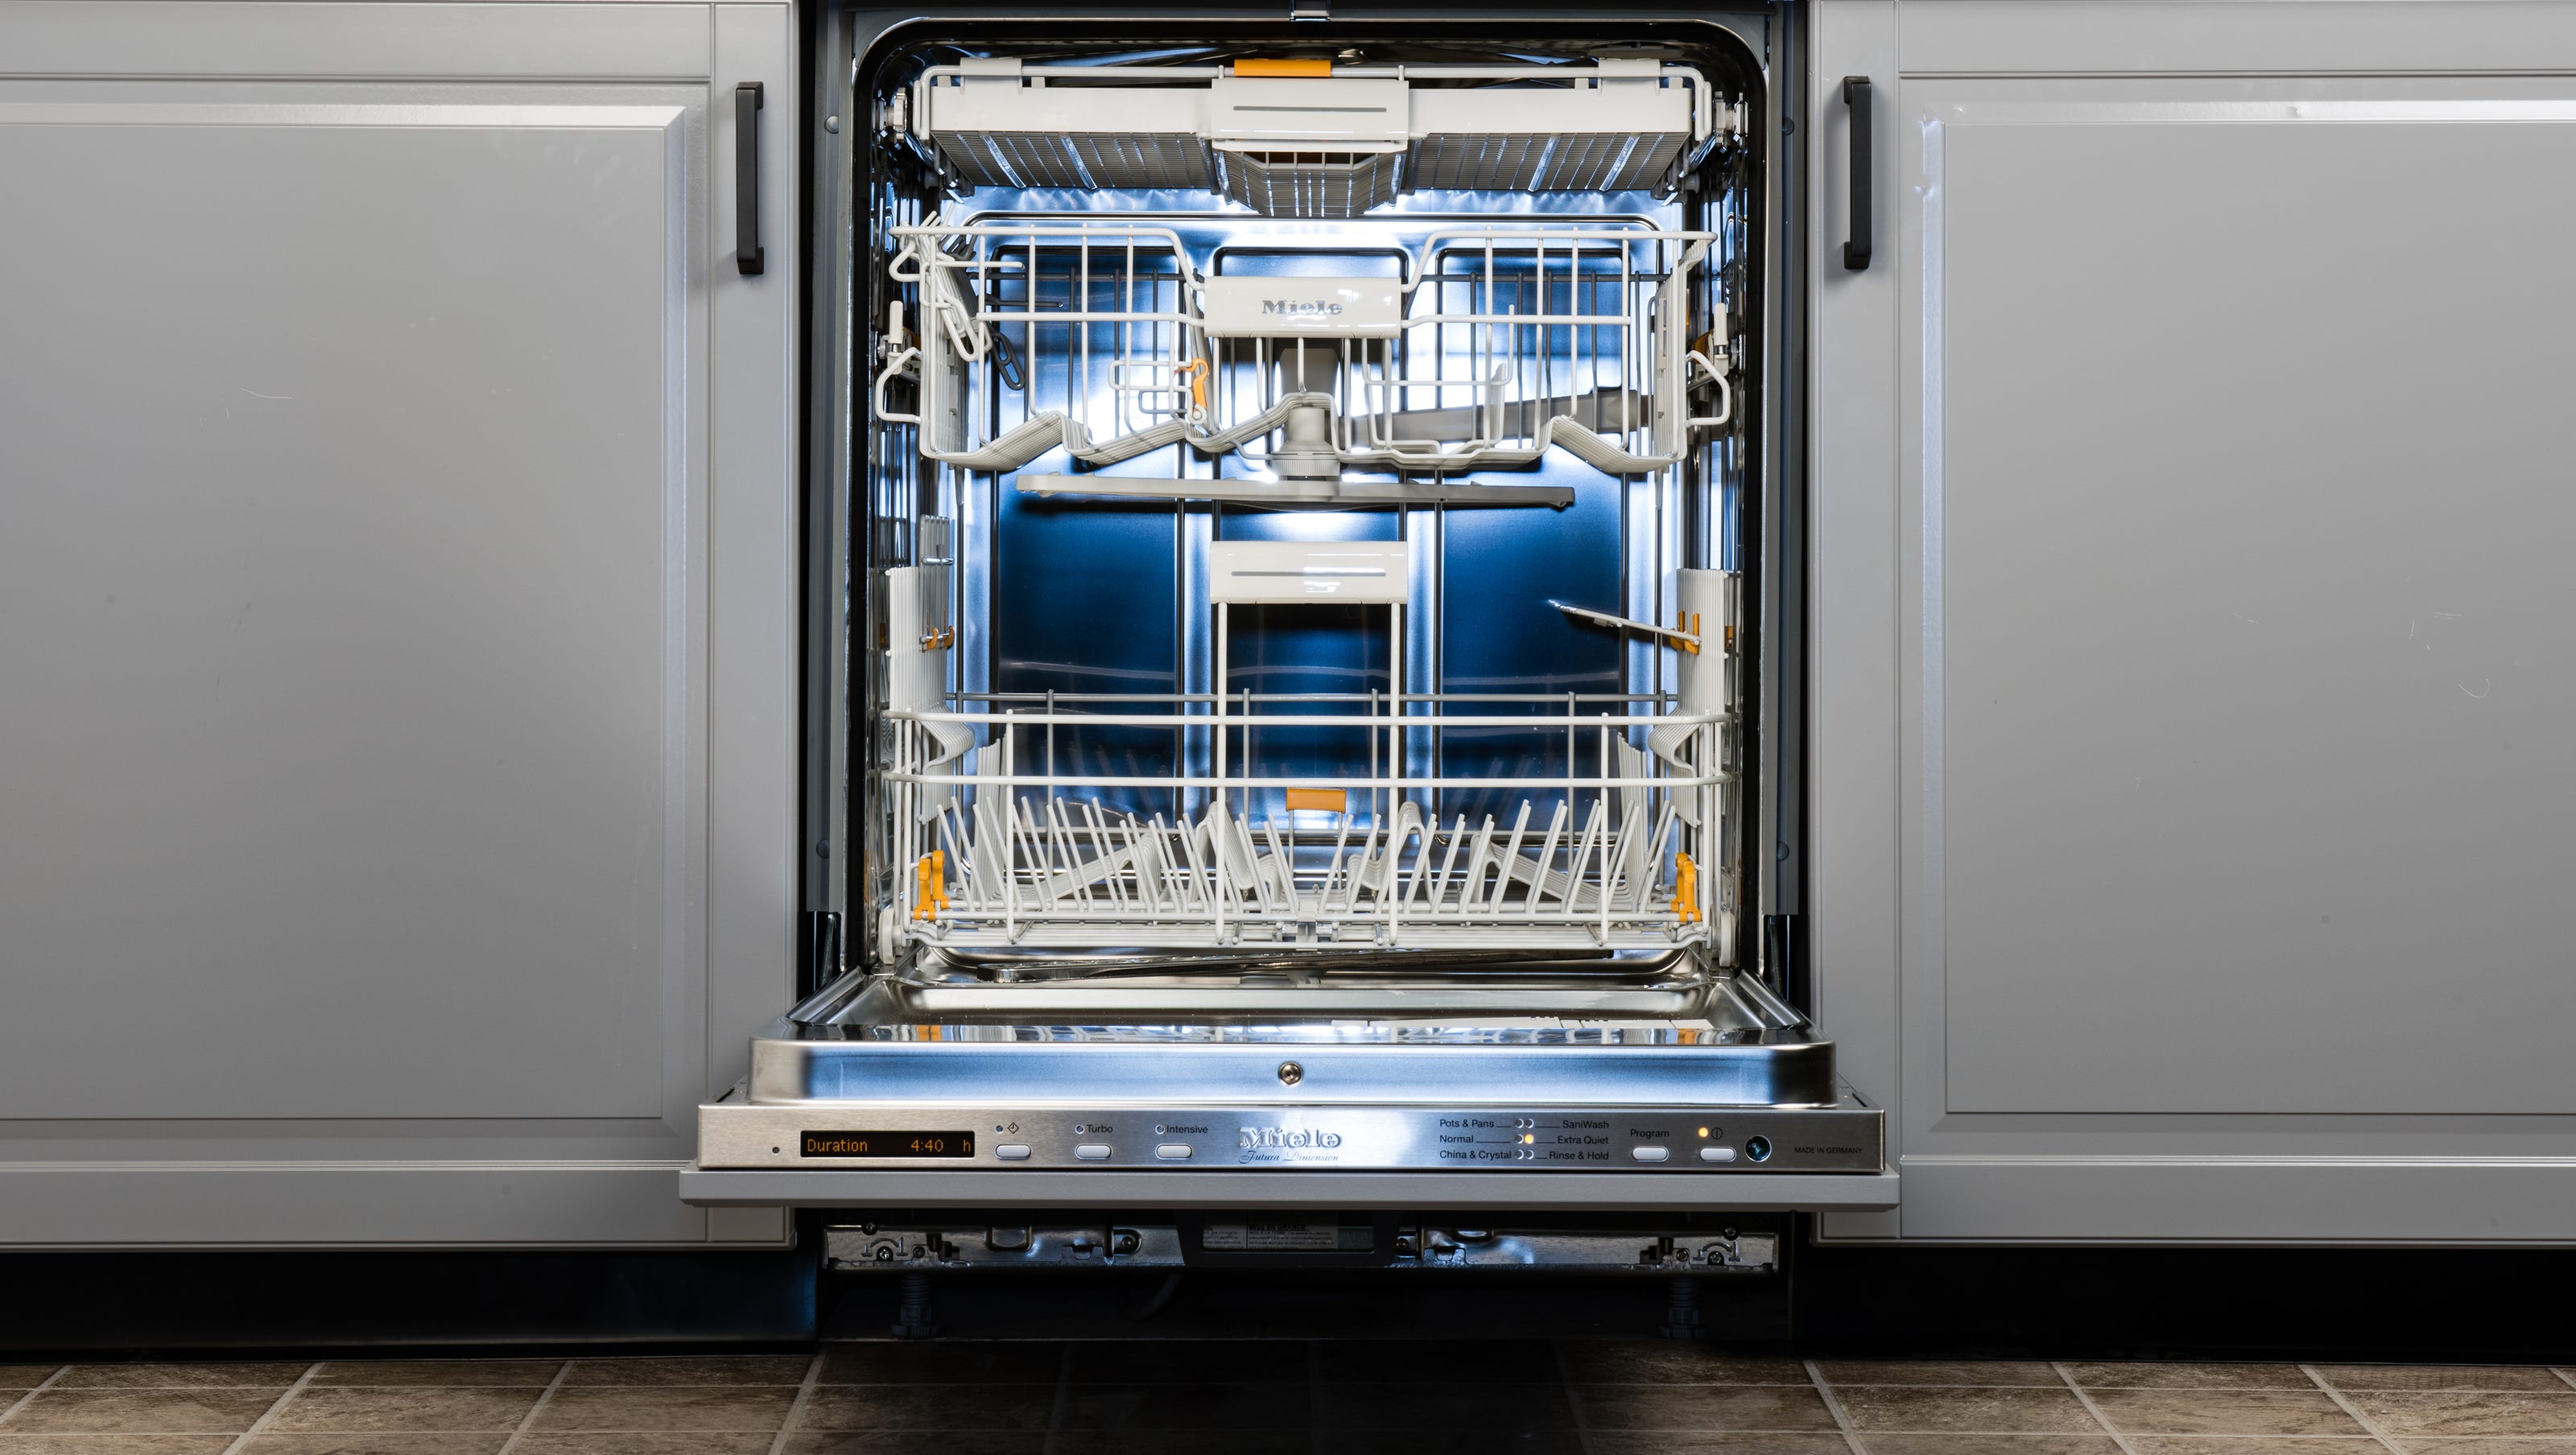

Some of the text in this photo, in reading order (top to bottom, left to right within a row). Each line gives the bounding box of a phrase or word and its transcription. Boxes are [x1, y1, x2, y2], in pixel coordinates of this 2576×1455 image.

[1261, 299, 1343, 315] Miele
[1439, 1119, 1495, 1127] Pots & Pans
[1563, 1119, 1609, 1128] SaniWash
[1087, 1124, 1113, 1133] Turbo
[1166, 1124, 1208, 1133] Intensive
[1238, 1127, 1342, 1148] Miele
[1630, 1129, 1670, 1139] Program
[1439, 1135, 1474, 1144] Normal
[1558, 1136, 1608, 1144] Extra Quiet
[807, 1140, 971, 1152] Duration 4:40 h
[1238, 1150, 1340, 1164] Futura Dimension
[1439, 1151, 1512, 1160] China & Crystal
[1549, 1151, 1609, 1160] Rinse & Hold
